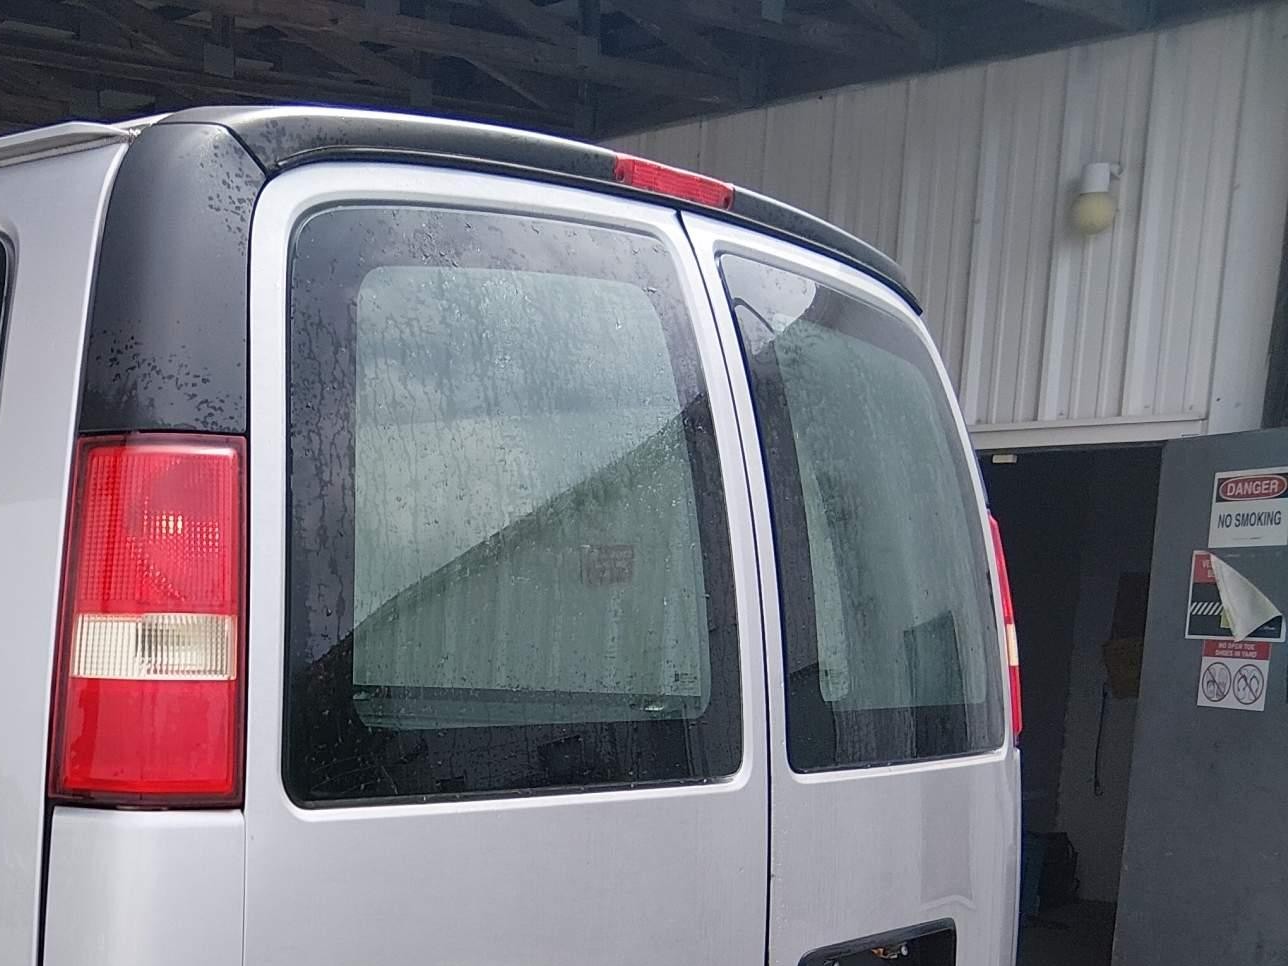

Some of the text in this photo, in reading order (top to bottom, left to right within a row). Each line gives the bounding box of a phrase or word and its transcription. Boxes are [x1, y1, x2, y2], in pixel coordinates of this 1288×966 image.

[1226, 479, 1279, 496] DANGER
[1217, 510, 1282, 528] NO SMOKING
